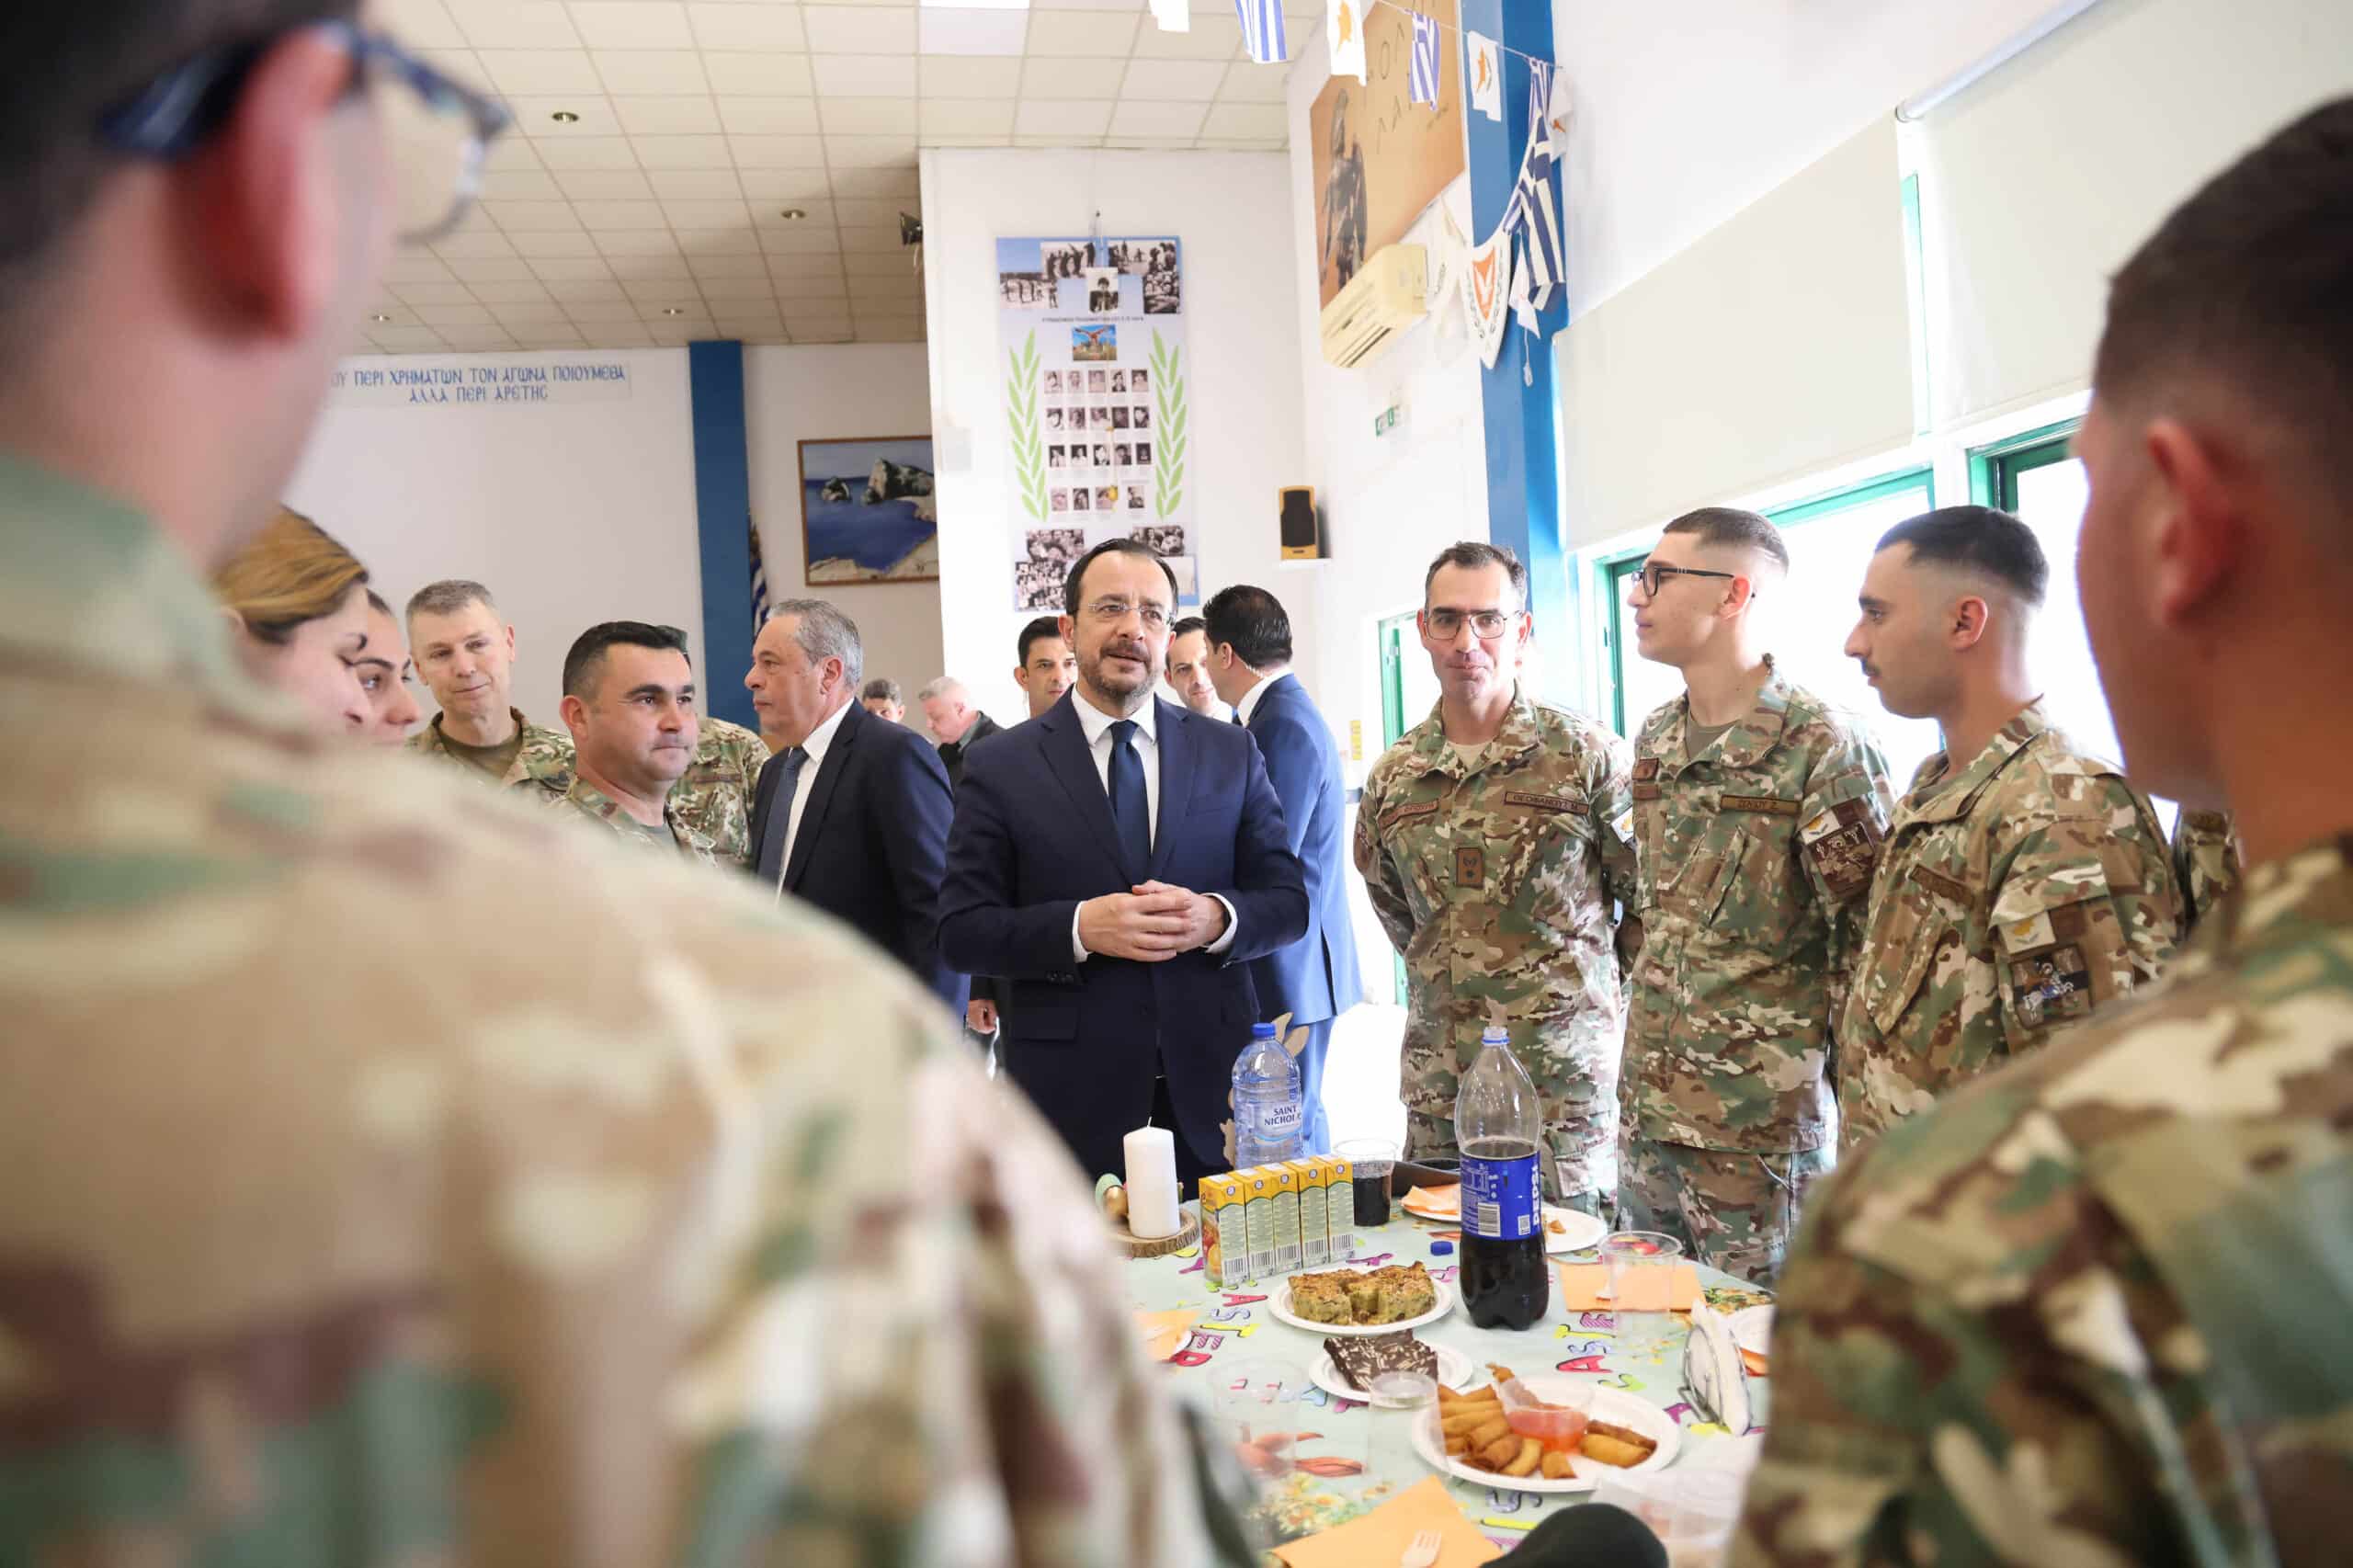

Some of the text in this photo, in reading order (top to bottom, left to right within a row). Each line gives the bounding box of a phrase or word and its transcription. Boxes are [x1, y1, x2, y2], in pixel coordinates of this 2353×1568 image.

[354, 370, 383, 386] ΠΕΡΙ
[390, 369, 462, 385] ΧΡΗΜΑΤΩΝ
[470, 368, 497, 383] ΤΟΝ
[502, 367, 549, 382] ΑΓΩΝΑ
[410, 389, 449, 403] ΑΛΛΑ
[456, 386, 486, 403] ΠΕΡΙ
[1273, 1105, 1297, 1117] SAINT
